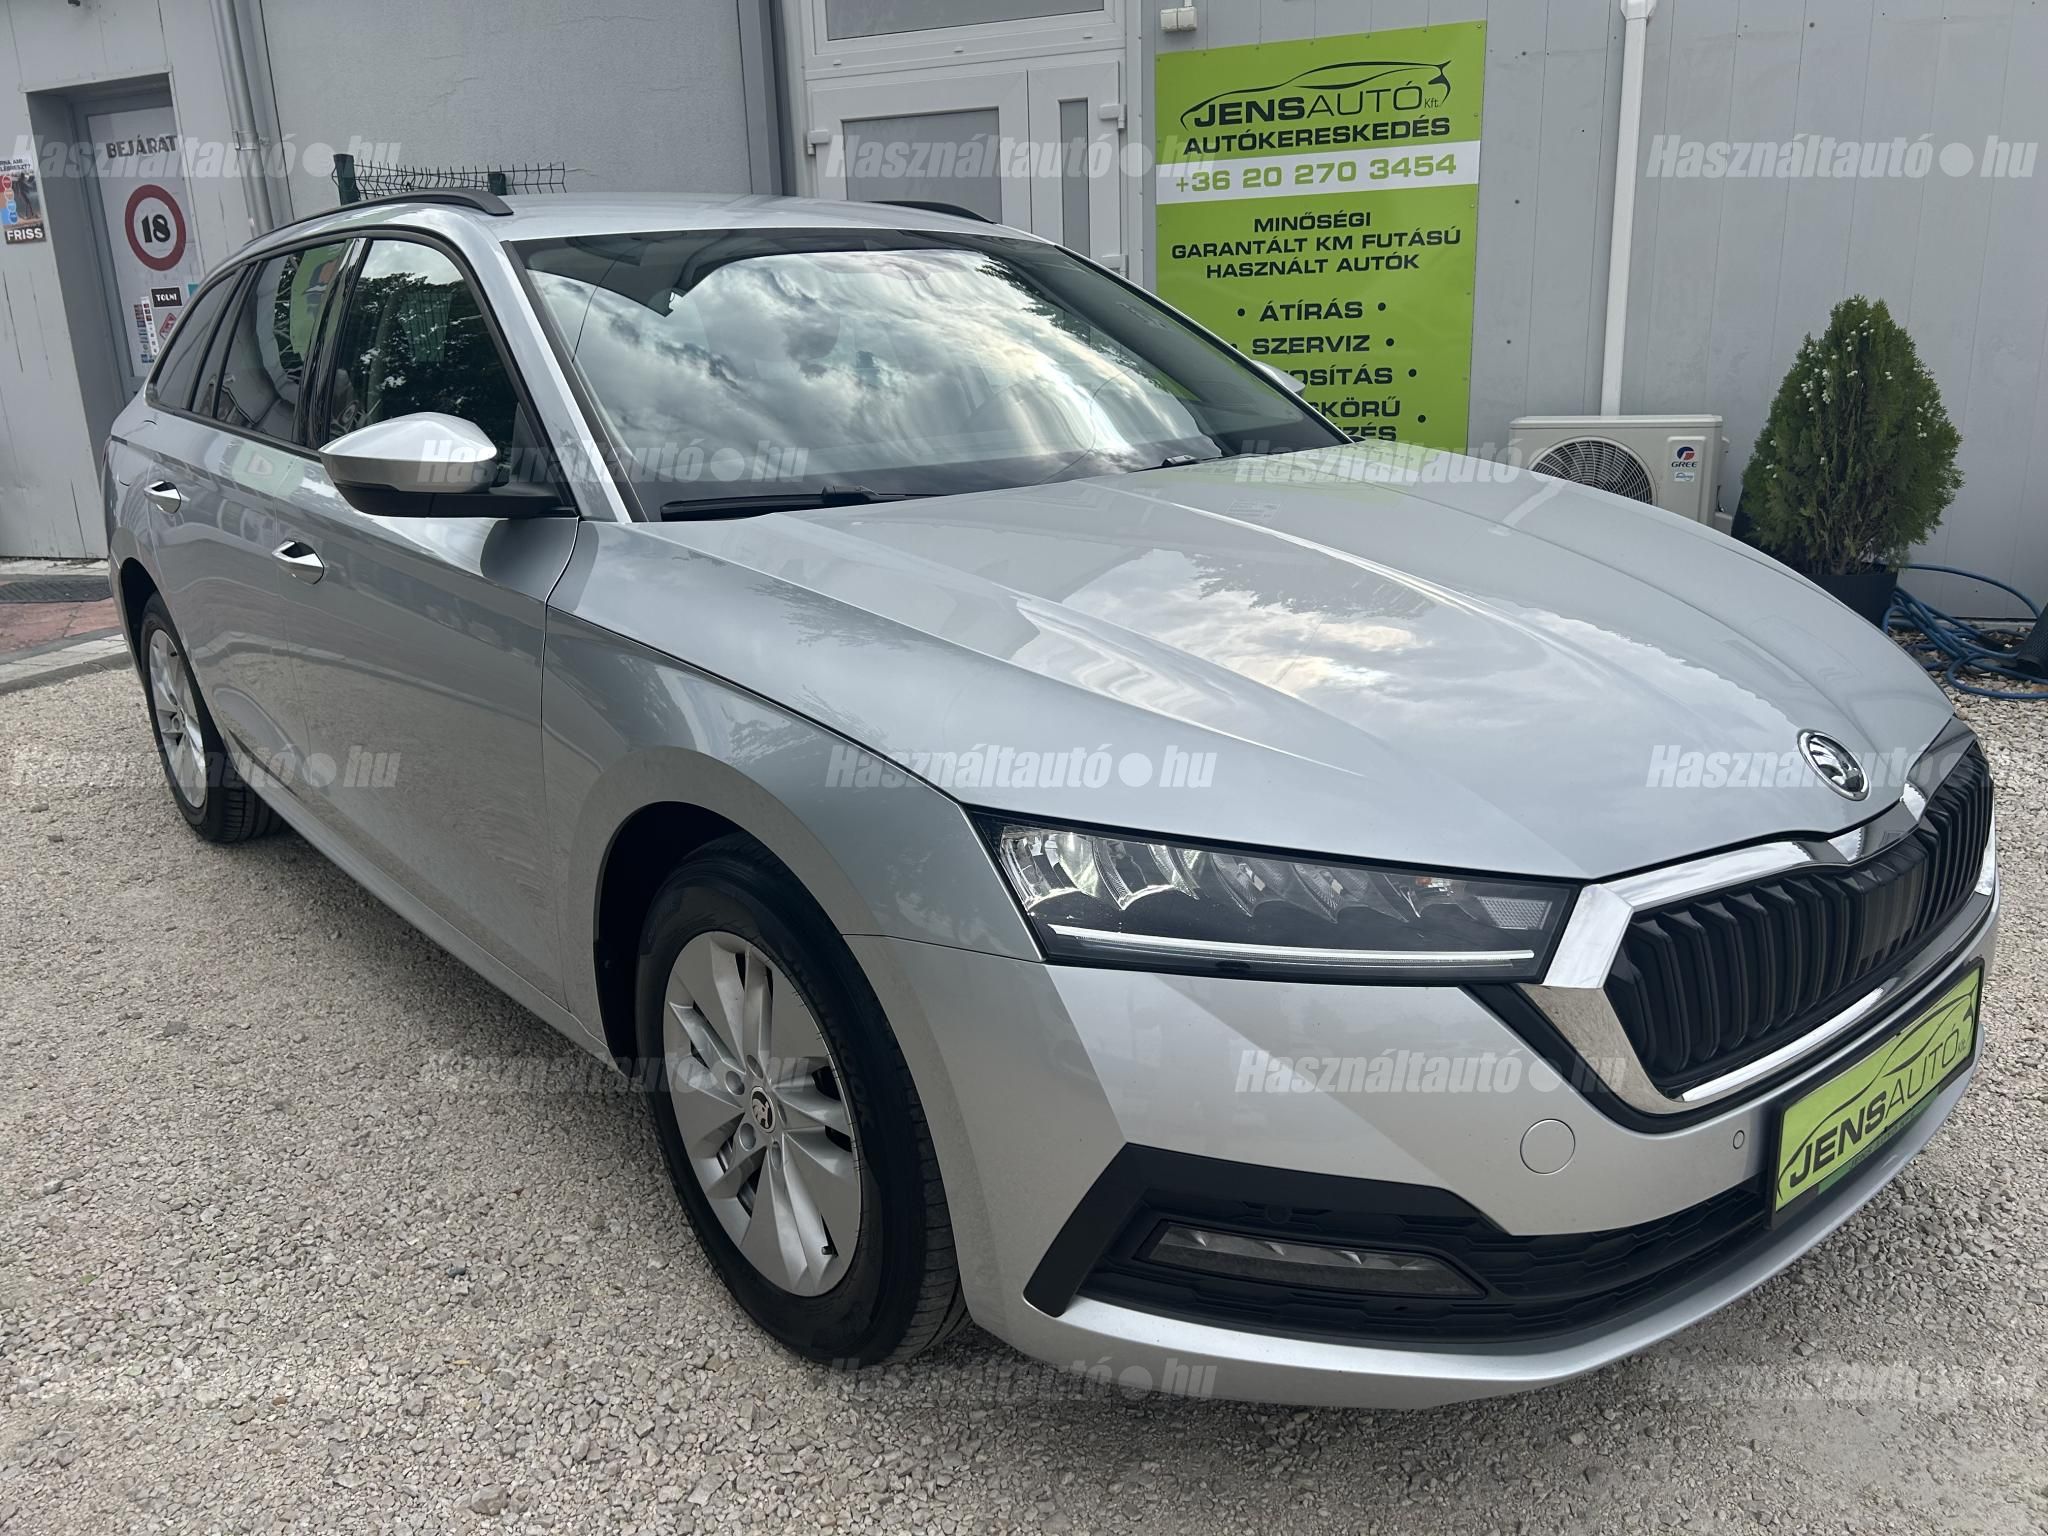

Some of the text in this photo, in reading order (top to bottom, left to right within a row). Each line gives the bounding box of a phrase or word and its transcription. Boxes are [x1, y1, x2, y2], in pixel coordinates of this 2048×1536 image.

[105, 134, 179, 159] BEJÁRAT
[1183, 115, 1451, 155] AUTÓKERESKEDÉS
[1176, 153, 1457, 193] +36 20 270 3454
[141, 213, 171, 243] 18
[1254, 210, 1371, 233] MINŐSÉGI
[6, 227, 44, 241] FRISS
[1172, 226, 1461, 259] GARANTÁLT KM FUTÁSÚ
[1206, 252, 1420, 279] HASZNÁLT AUTÓK
[155, 293, 178, 302] TOLNI
[1259, 298, 1364, 322] ÁTÍRÁS
[1252, 334, 1371, 355] SZERVIZ
[1284, 363, 1393, 386] OSÍTÁS
[1332, 422, 1397, 441] ZÉS
